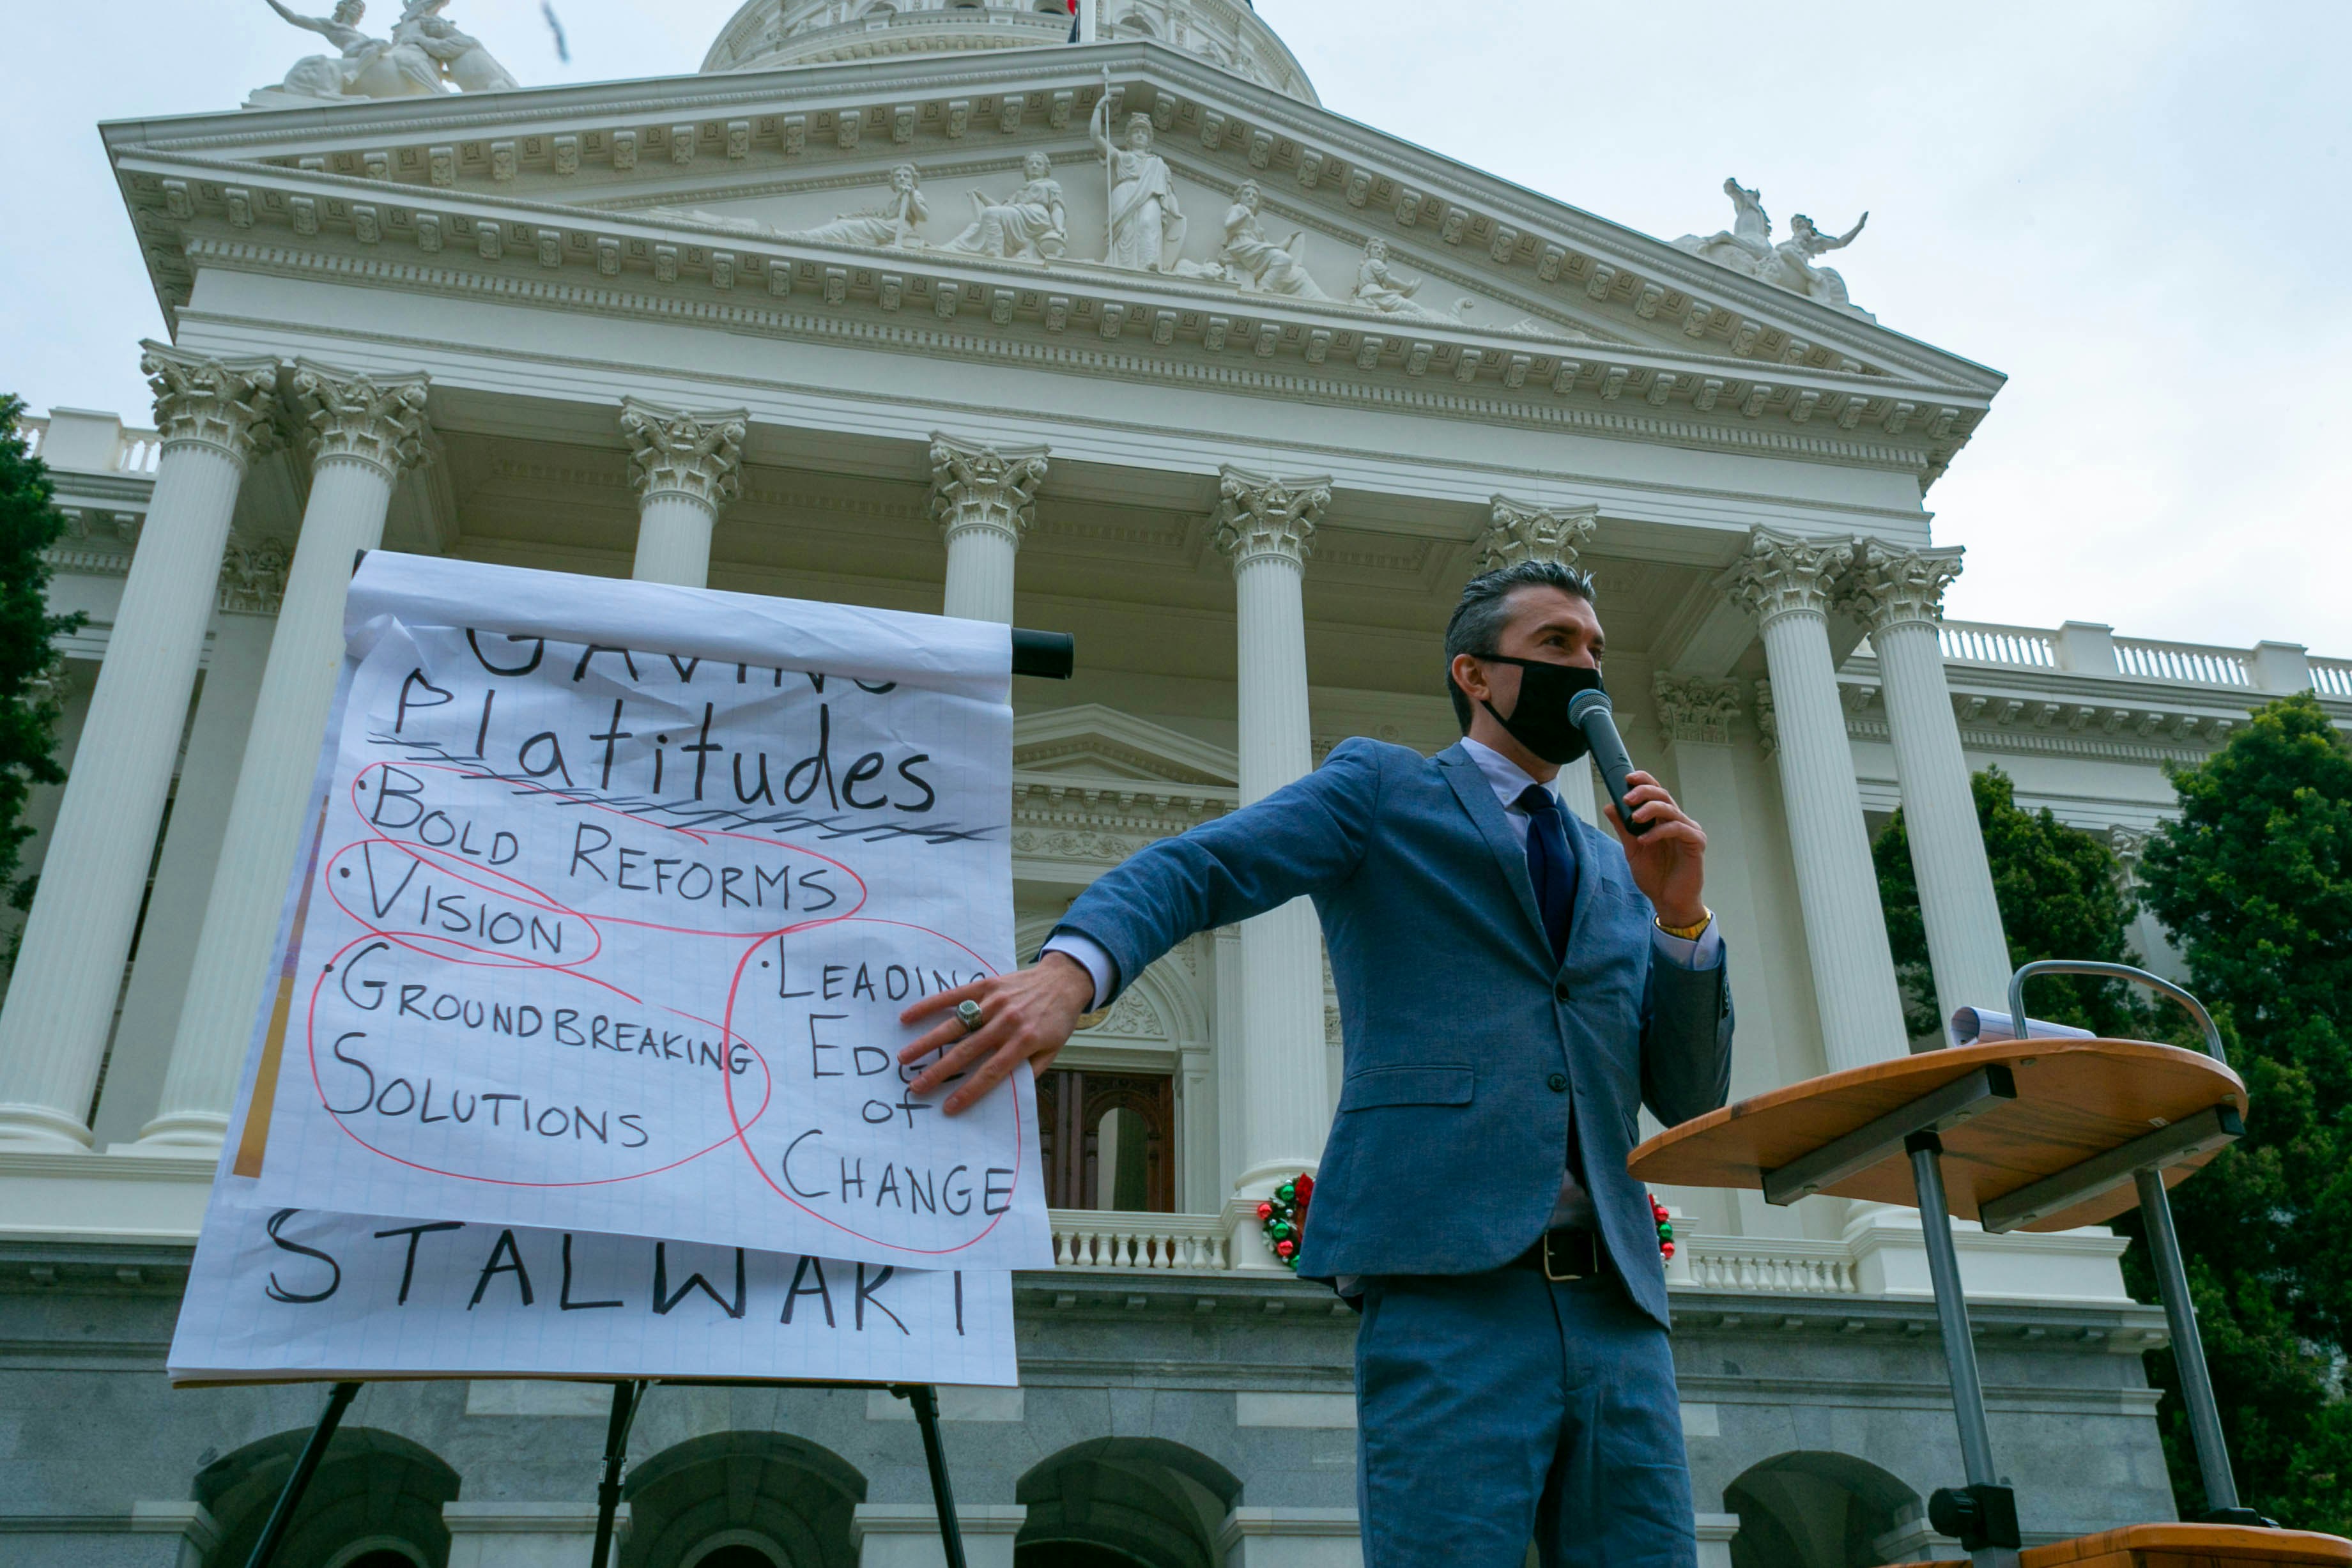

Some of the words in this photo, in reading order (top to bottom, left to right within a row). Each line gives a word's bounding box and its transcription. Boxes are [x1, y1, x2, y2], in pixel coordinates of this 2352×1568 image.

[395, 668, 936, 814] Platitudes
[372, 764, 519, 865] BOLD
[570, 821, 837, 912] REFORMS
[364, 841, 562, 954] VISION
[341, 942, 754, 1075] GROUNDBREAKING
[322, 1032, 649, 1148] SOLUTIONS
[863, 1087, 933, 1128] of
[783, 1129, 1015, 1215] CHANGE
